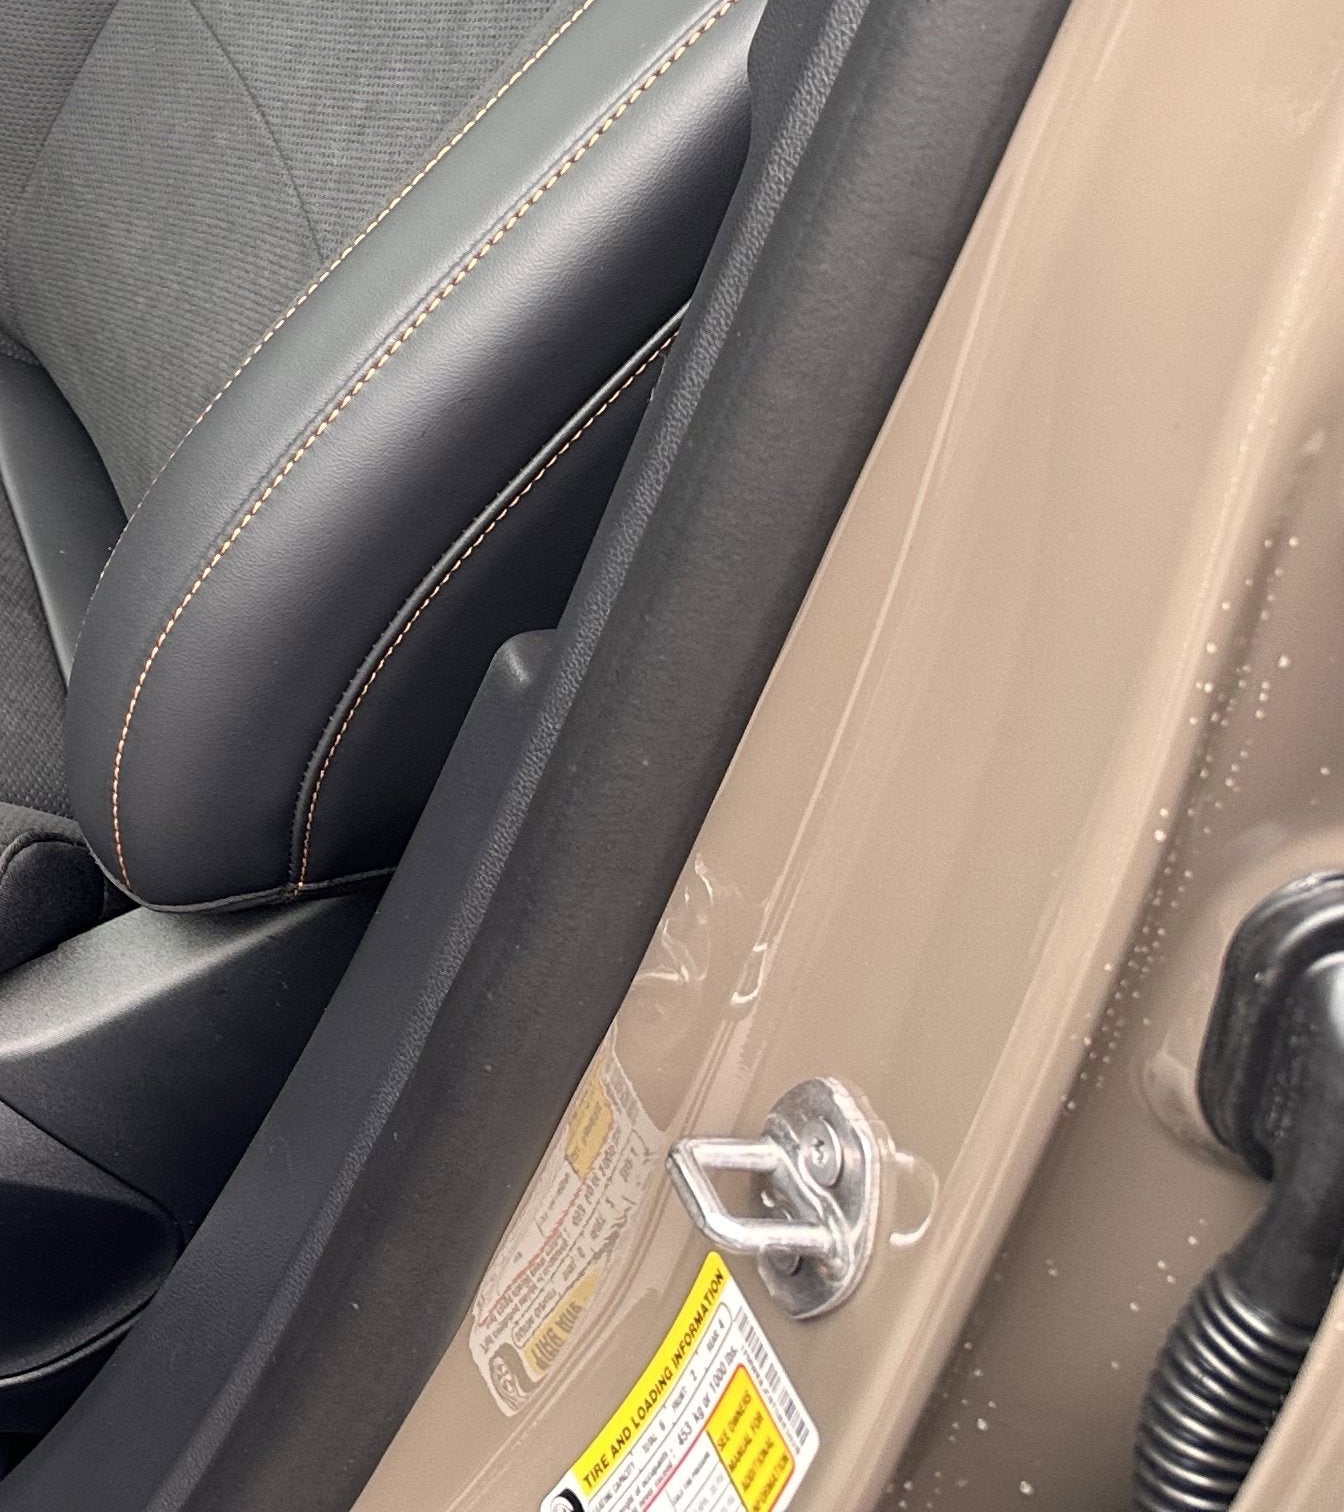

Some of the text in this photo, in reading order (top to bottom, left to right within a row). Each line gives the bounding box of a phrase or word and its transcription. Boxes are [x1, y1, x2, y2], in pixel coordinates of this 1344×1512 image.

[582, 1452, 609, 1488] TIRE
[610, 1426, 631, 1458] AND
[630, 1365, 672, 1429] LOADING
[671, 1268, 724, 1369] INFORMATION
[676, 1420, 693, 1446] 453
[691, 1405, 705, 1423] kg
[709, 1360, 728, 1393] 1000
[688, 1368, 698, 1382] 2
[728, 1432, 752, 1473] MANUAL
[749, 1410, 765, 1435] FOR
[752, 1452, 790, 1511] NFORMATION
